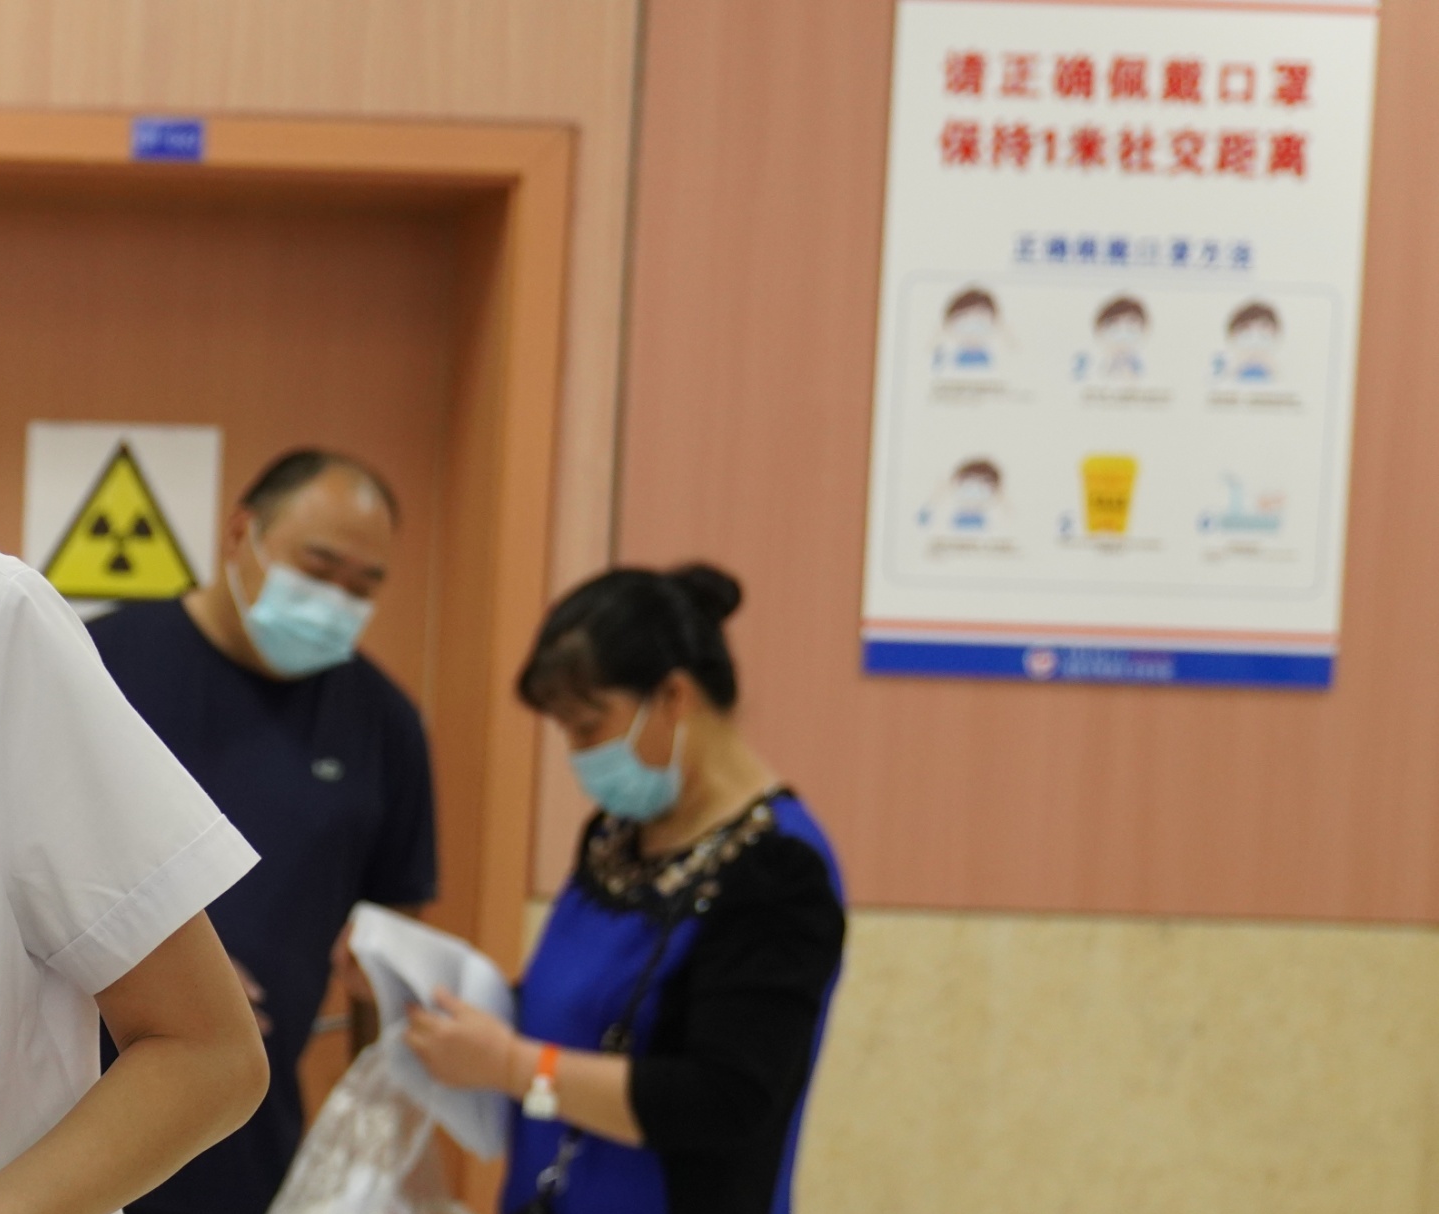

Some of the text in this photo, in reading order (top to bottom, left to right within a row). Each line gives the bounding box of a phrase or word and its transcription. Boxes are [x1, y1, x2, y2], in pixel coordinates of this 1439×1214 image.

[943, 52, 1314, 105] 请正确佩戴口罩
[940, 119, 1310, 178] 保持1米社交距离
